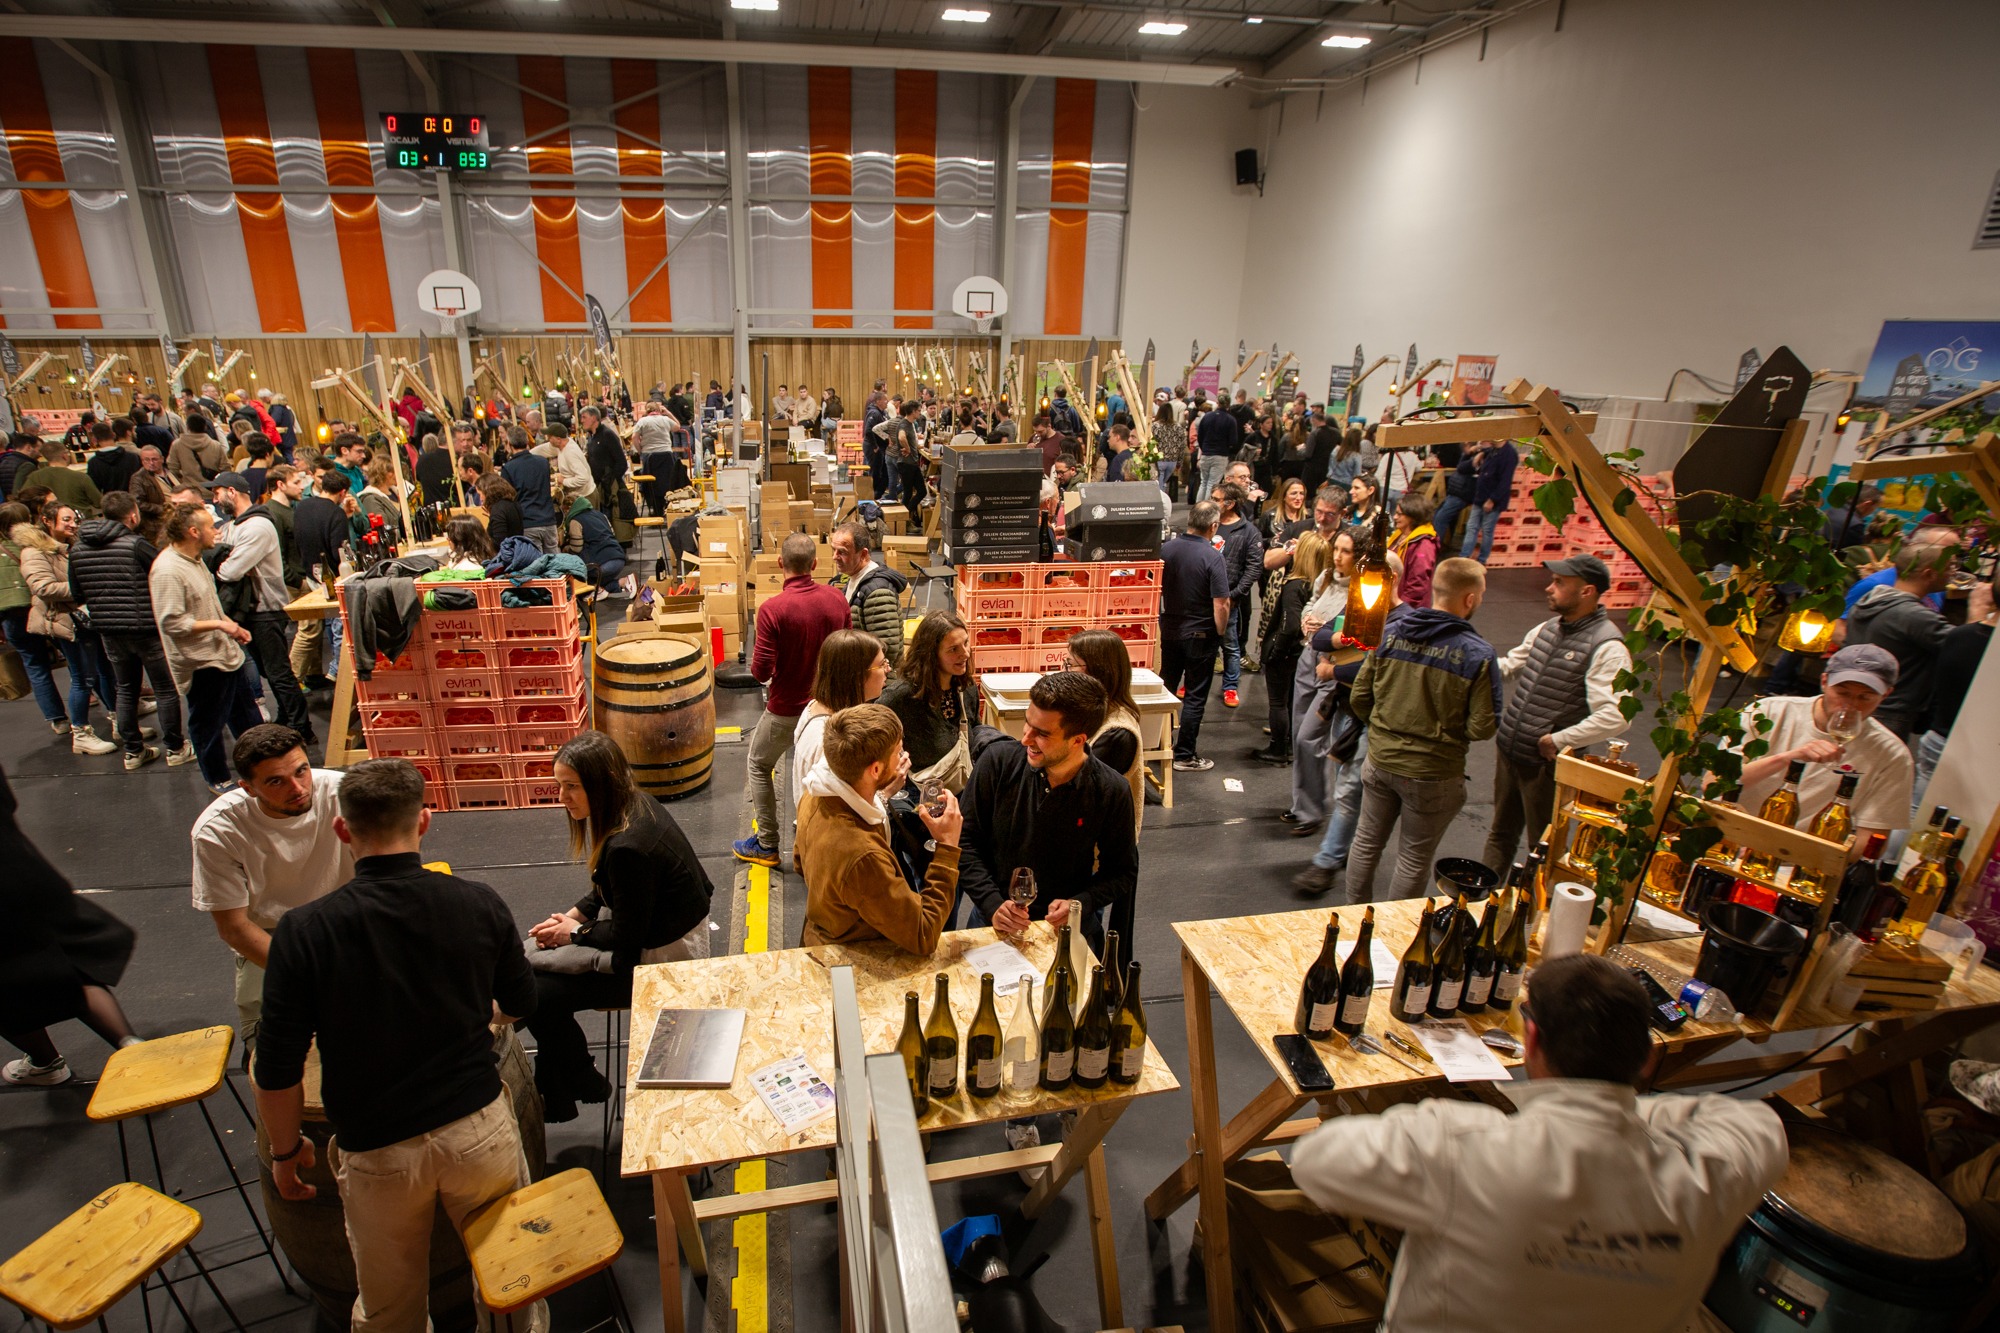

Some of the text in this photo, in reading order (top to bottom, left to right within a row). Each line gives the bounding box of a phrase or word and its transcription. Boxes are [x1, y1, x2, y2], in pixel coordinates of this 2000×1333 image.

[387, 116, 396, 132] 0
[471, 118, 480, 134] 0
[446, 137, 484, 146] VISITEUR
[400, 151, 418, 165] 03
[459, 152, 487, 167] 853
[1458, 361, 1495, 379] WHISKY
[982, 598, 1014, 609] evian
[1045, 651, 1069, 663] evia
[446, 677, 482, 689] evian
[519, 676, 555, 688] evian
[534, 784, 560, 796] evia
